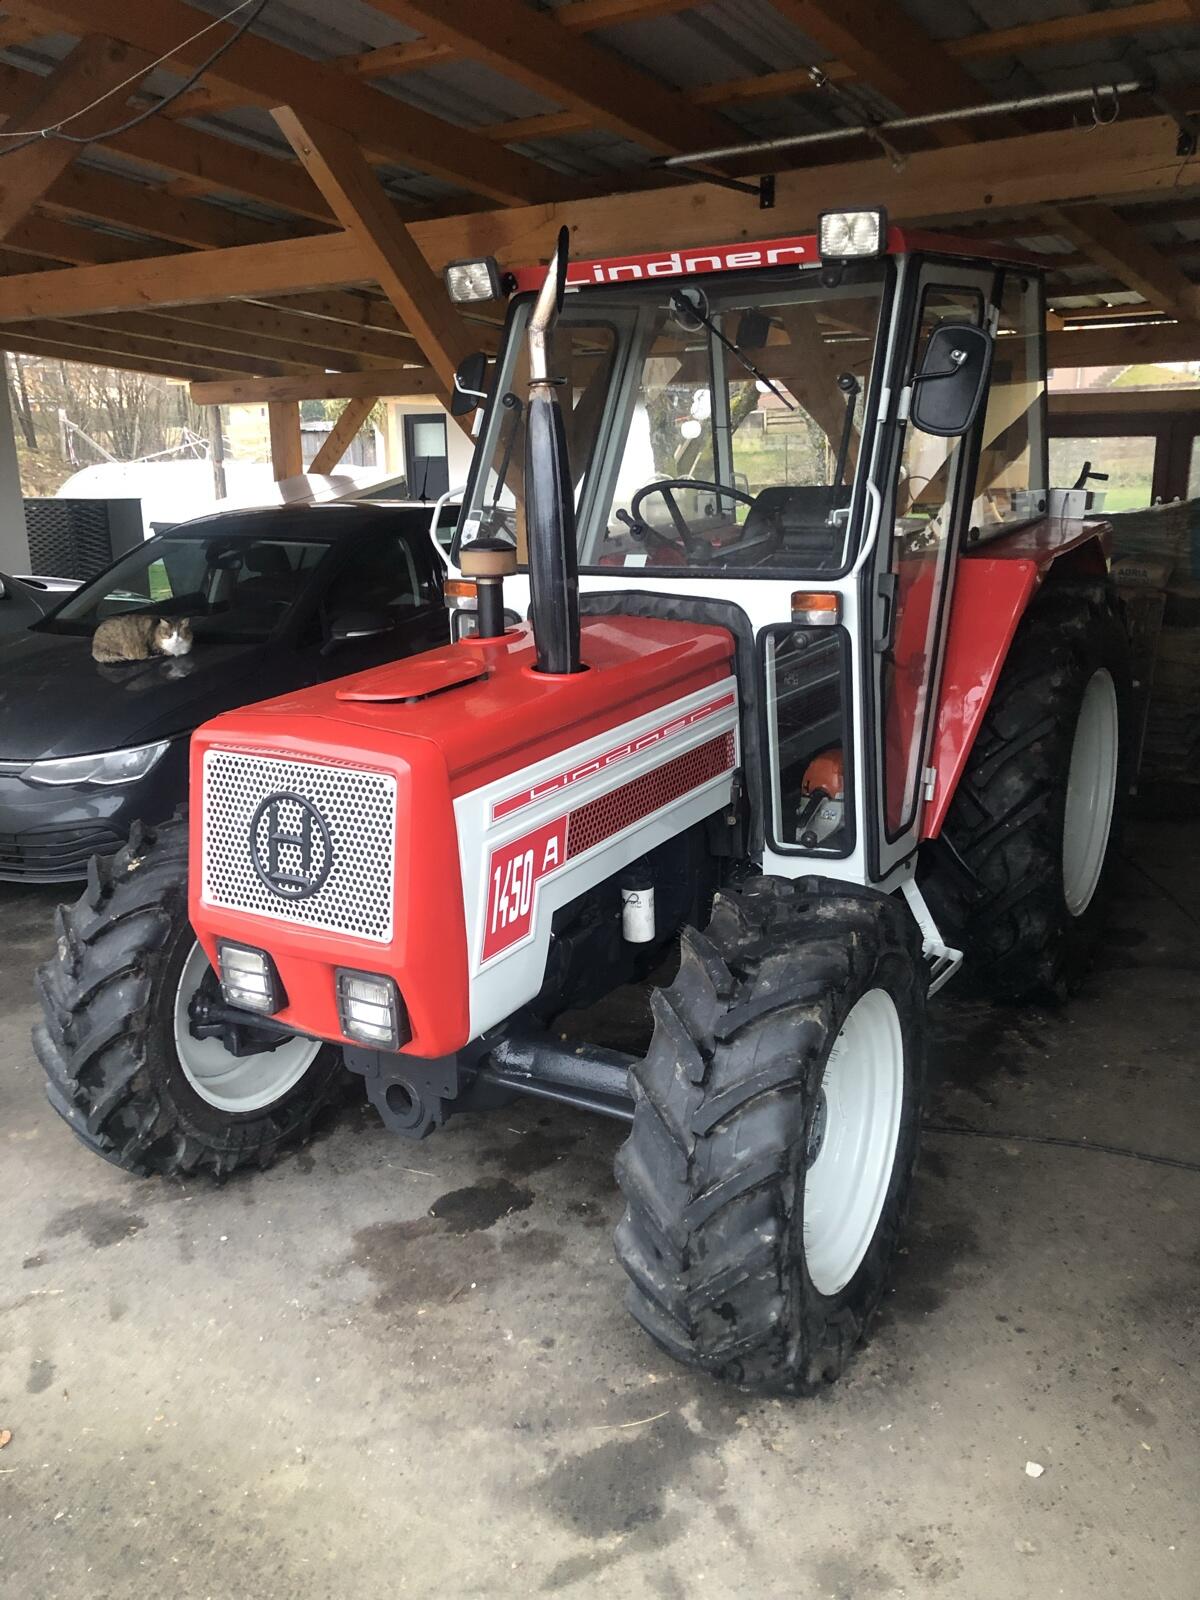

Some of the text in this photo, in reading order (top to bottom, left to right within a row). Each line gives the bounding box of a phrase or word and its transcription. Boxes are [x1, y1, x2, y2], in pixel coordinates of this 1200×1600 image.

[530, 707, 712, 800] Lindner
[491, 835, 558, 934] 1450 A
